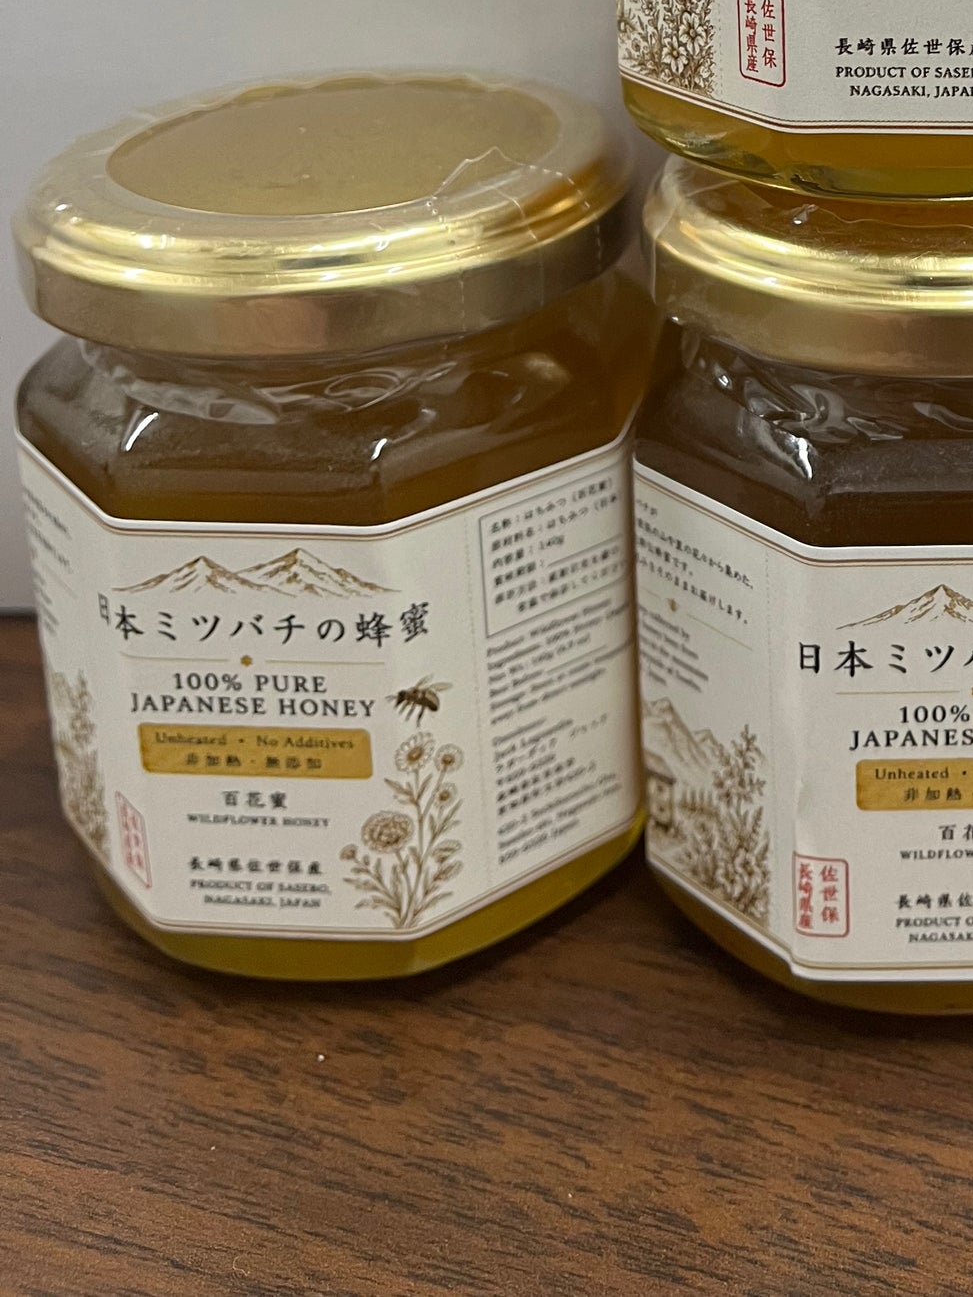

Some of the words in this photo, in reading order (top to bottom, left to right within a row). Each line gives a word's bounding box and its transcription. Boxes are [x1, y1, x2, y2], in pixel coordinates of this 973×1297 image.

[835, 66, 907, 79] PRODUCT
[911, 66, 930, 79] OF
[850, 85, 930, 98] NAGASAKI,
[98, 593, 430, 648] 日本ミツバチの蜂蜜
[173, 672, 243, 691] 100%
[255, 674, 328, 694] PURE
[130, 692, 267, 716] JAPANESE
[278, 698, 377, 717] HONEY
[898, 704, 971, 724] 100%
[155, 731, 228, 746] Unheated
[256, 734, 278, 748] No
[284, 735, 354, 750] Additives
[875, 766, 949, 781] Unheated
[896, 916, 961, 928] PRODUCT
